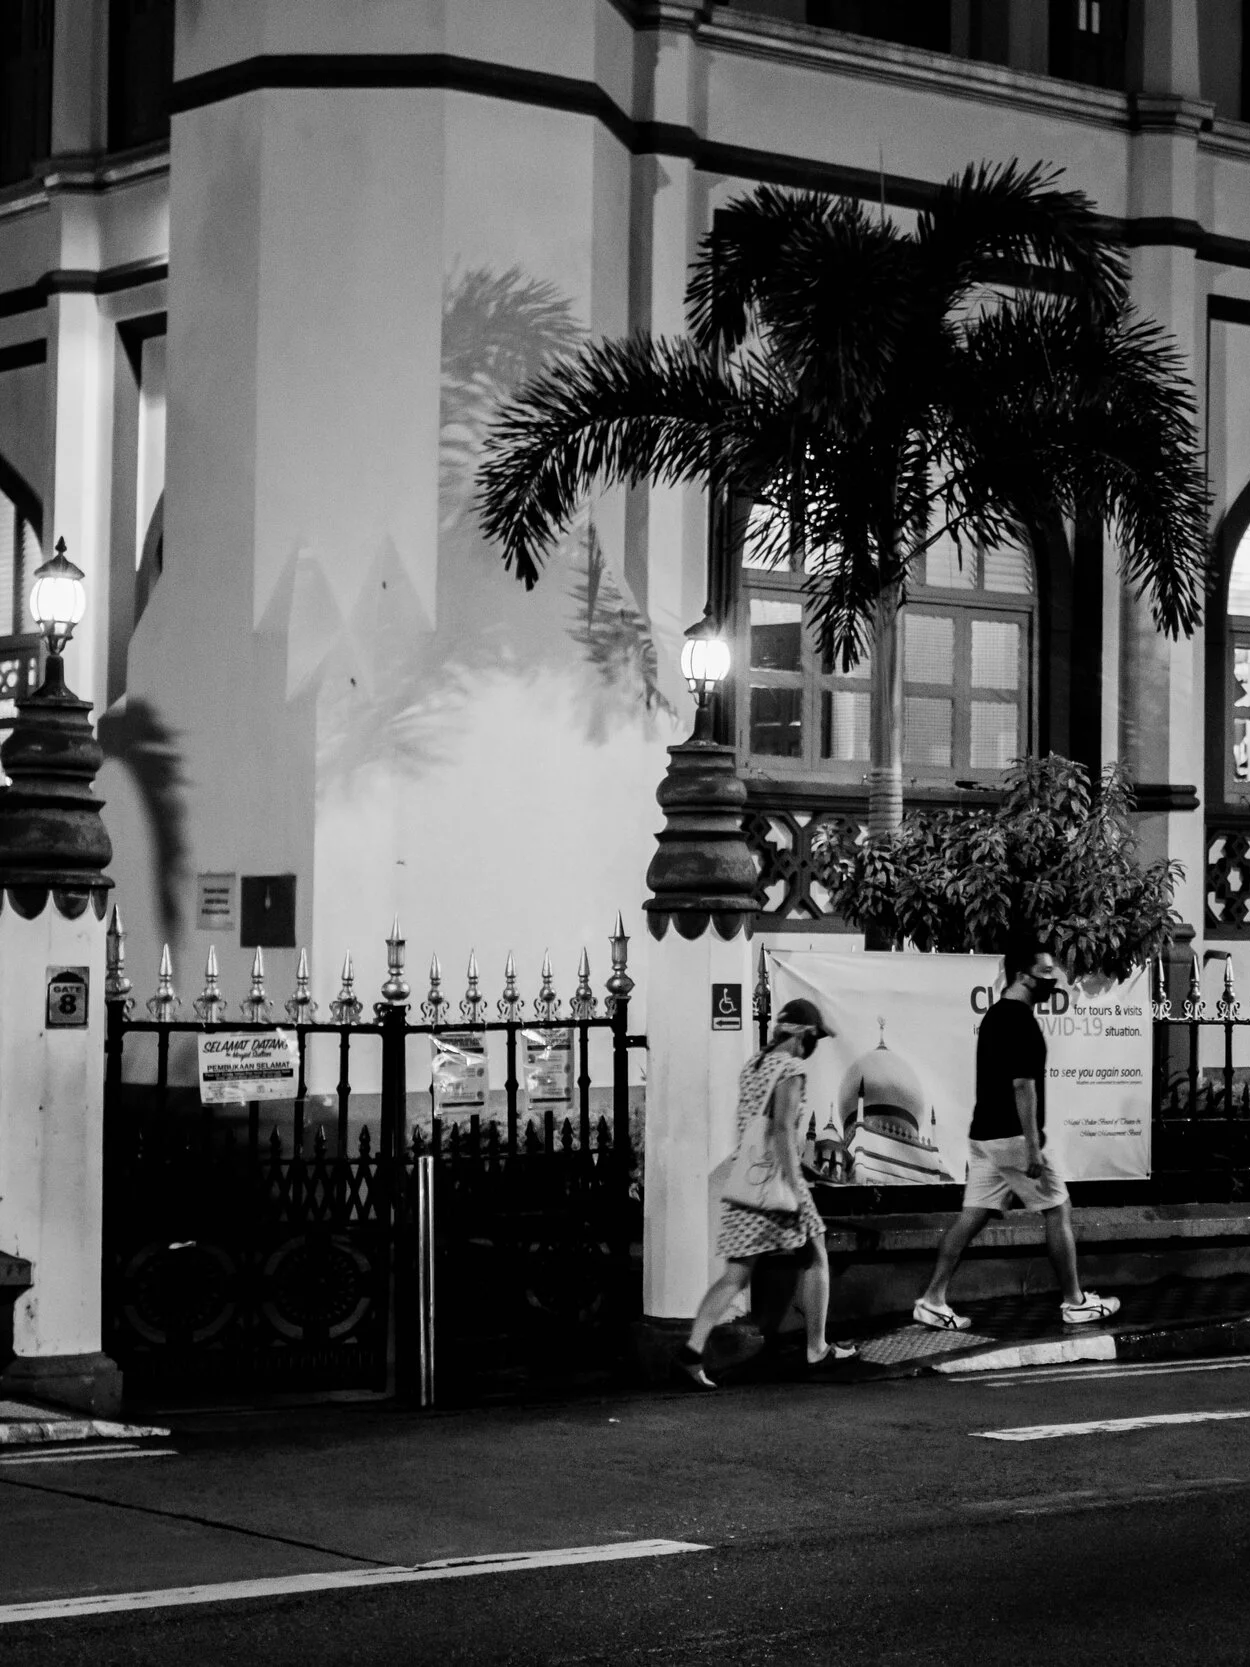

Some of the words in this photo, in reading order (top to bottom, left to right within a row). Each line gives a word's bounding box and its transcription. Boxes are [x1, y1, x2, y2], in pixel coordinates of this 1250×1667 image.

[59, 994, 76, 1015] 8
[970, 986, 1069, 1015] CLED
[1074, 1004, 1086, 1015] for
[1089, 1005, 1112, 1015] tours
[1115, 1004, 1121, 1016] &
[1123, 1005, 1142, 1016] visits
[1105, 1026, 1142, 1036] situation.
[202, 1040, 250, 1054] SELAMAT
[251, 1039, 289, 1051] DATANG
[256, 1060, 290, 1070] SELAMAT
[1050, 1067, 1059, 1078] to
[1061, 1068, 1076, 1078] see
[1078, 1068, 1093, 1080] you
[1096, 1066, 1119, 1080] again
[1121, 1068, 1143, 1078] soon.
